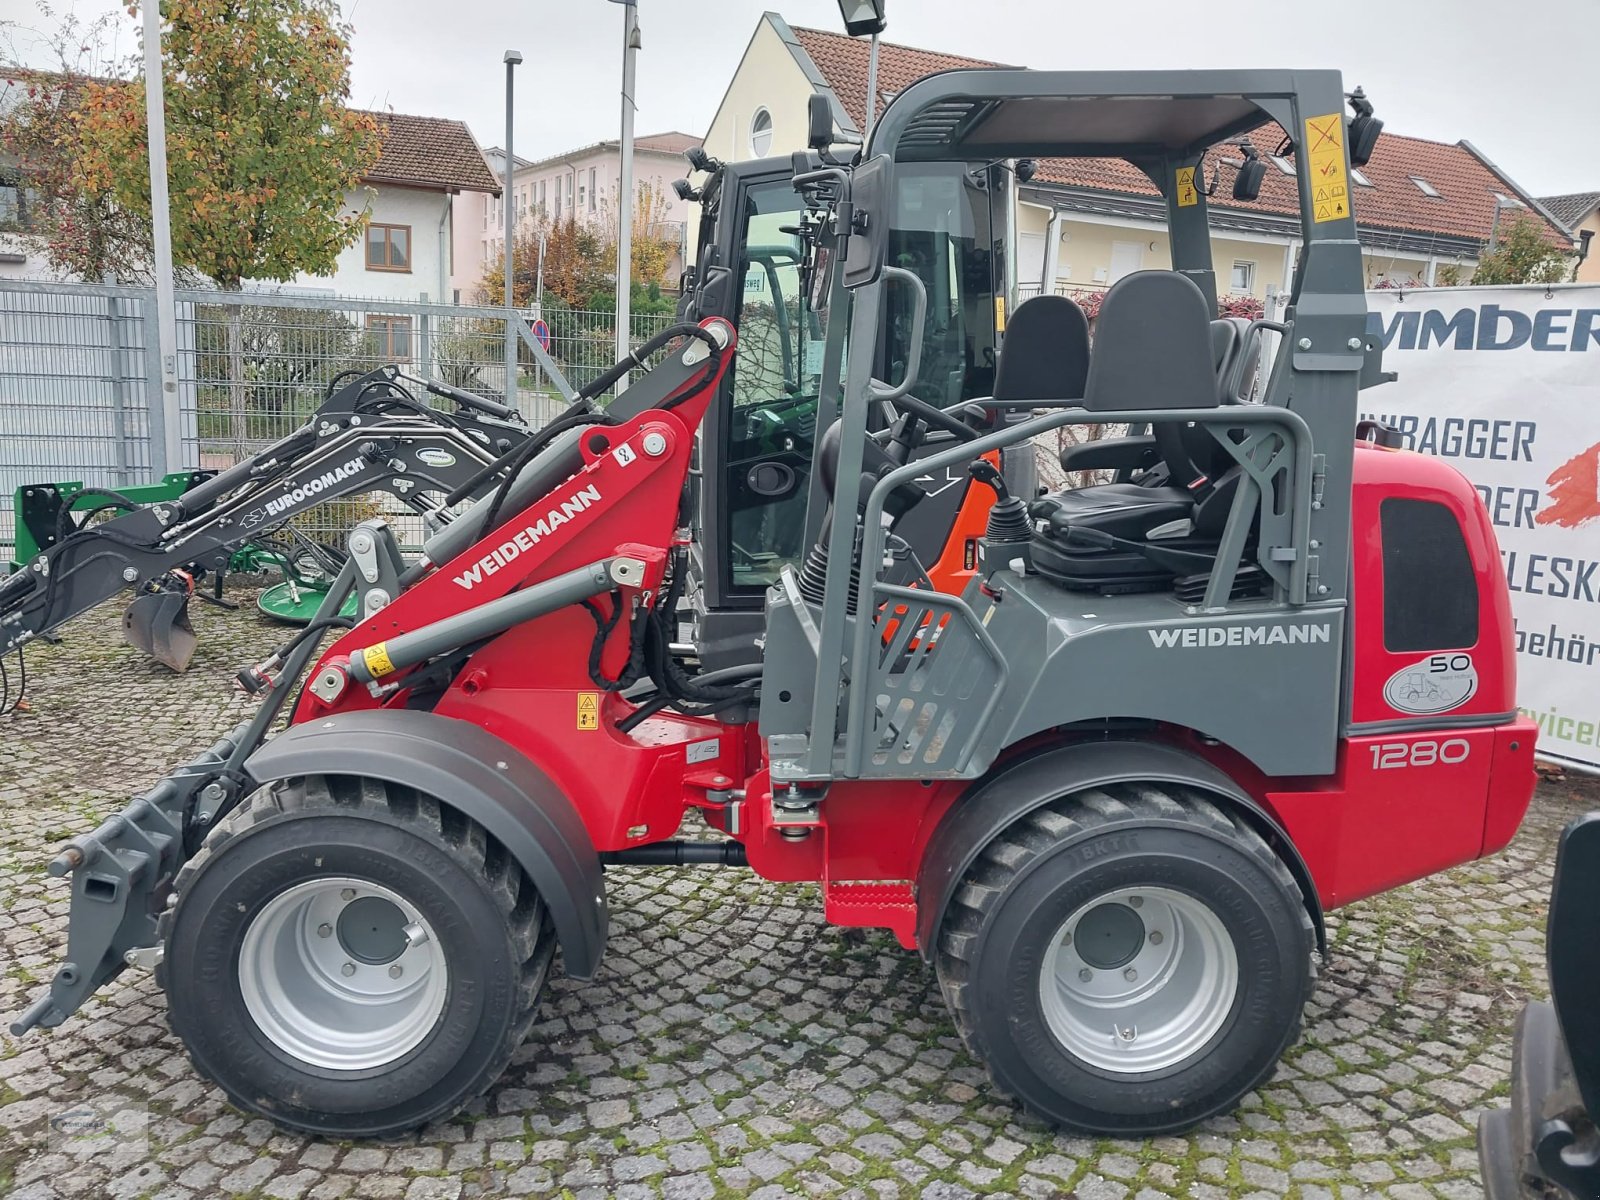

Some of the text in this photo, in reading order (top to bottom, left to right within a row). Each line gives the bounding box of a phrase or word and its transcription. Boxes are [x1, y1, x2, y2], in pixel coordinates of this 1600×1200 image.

[265, 456, 366, 516] EUROCOMACH
[452, 484, 602, 590] WEIDEMANN
[1148, 624, 1330, 648] WEIDEMANN
[1430, 655, 1470, 673] 50
[1369, 738, 1470, 769] 1280
